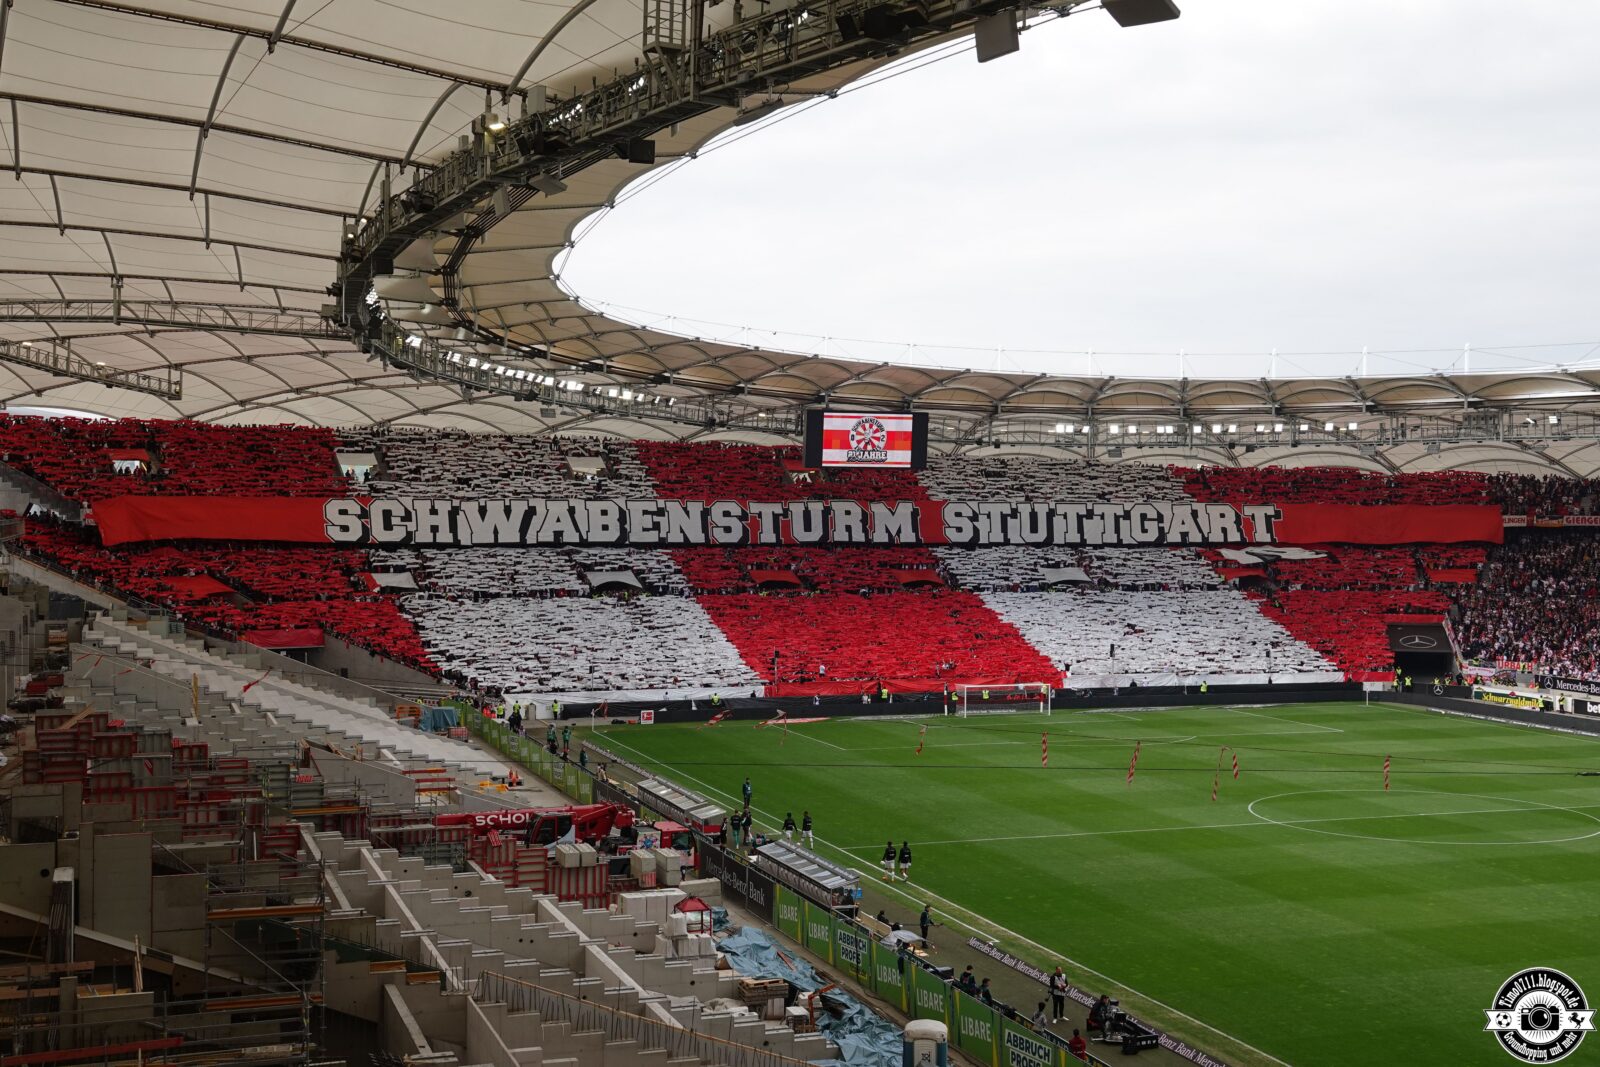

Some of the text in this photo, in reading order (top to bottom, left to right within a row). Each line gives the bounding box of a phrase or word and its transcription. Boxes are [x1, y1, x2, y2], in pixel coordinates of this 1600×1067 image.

[859, 451, 887, 459] JAHRE
[323, 499, 1282, 545] SCHWABENSTURM STUTTGART
[1565, 516, 1600, 525] GIENGE
[1497, 660, 1533, 671] URBAH
[749, 881, 765, 907] Bank
[779, 904, 798, 922] LIBARE
[808, 922, 829, 942] LIBARE
[841, 946, 861, 965] PROFS
[916, 988, 945, 1013] LIBARE
[968, 936, 1004, 960] Mercedes-Benz
[1002, 953, 1018, 967] Bank
[1015, 960, 1050, 986] Mercedes-Ben
[1175, 1042, 1197, 1060] Bank
[960, 1015, 992, 1042] LIBARE
[1006, 1031, 1050, 1062] ABBRUCH
